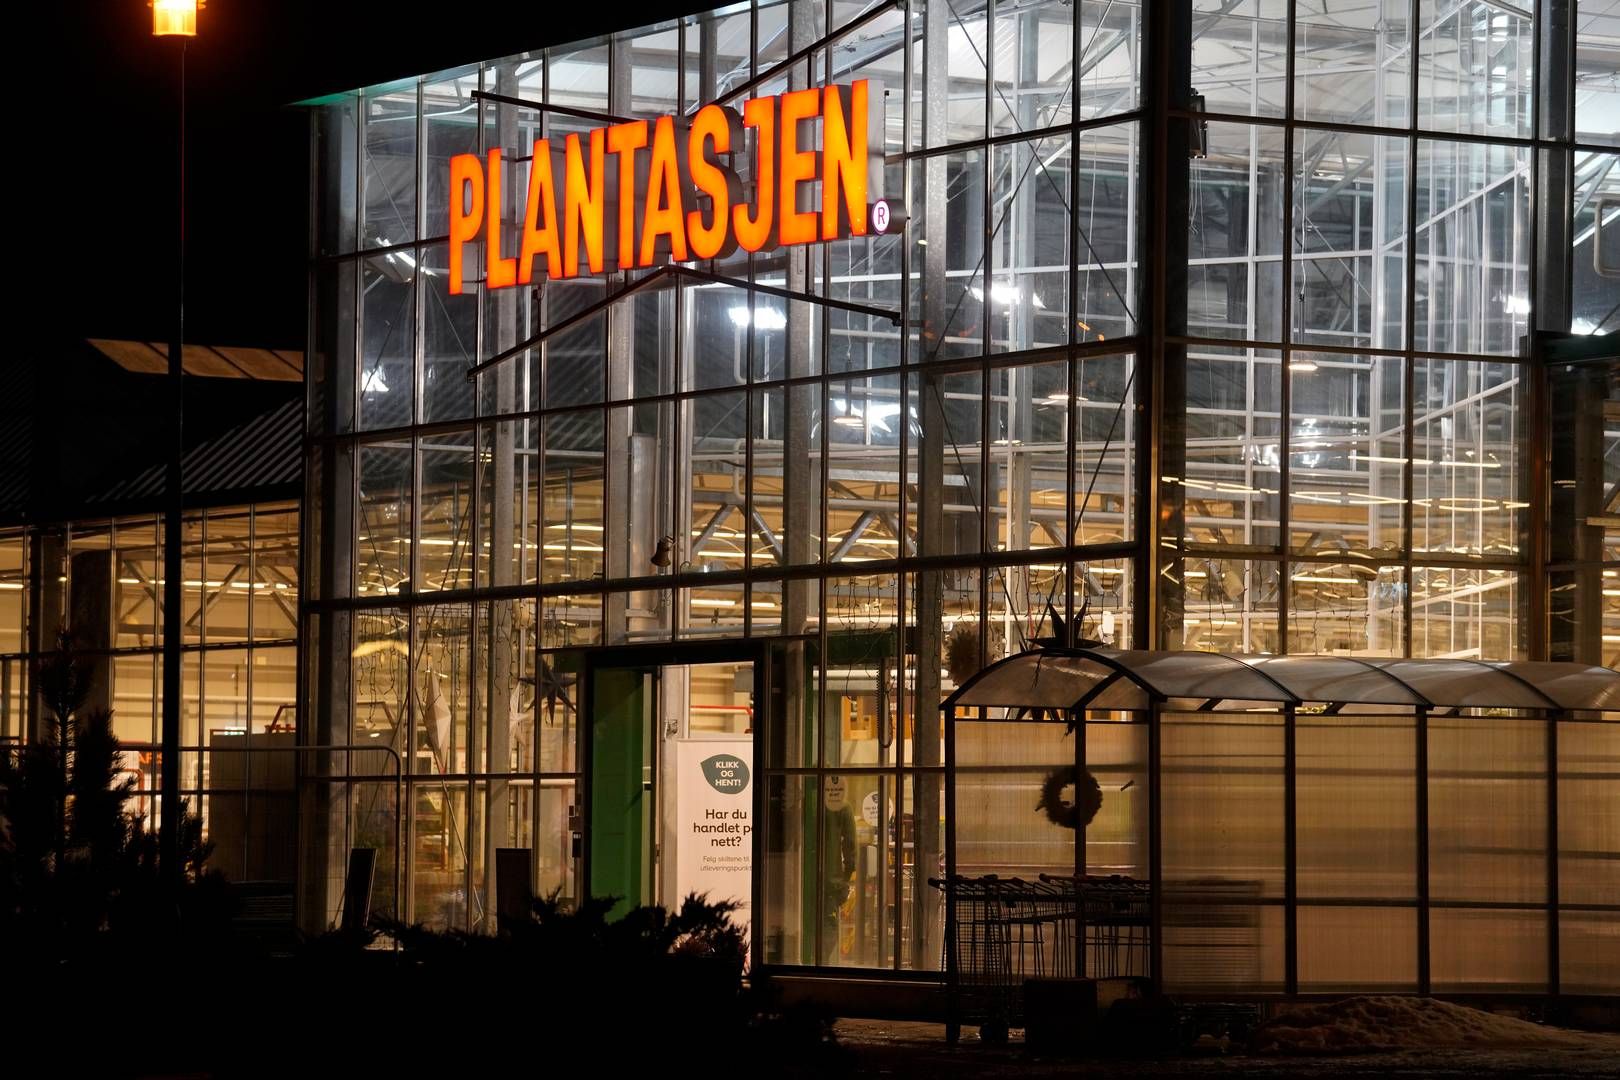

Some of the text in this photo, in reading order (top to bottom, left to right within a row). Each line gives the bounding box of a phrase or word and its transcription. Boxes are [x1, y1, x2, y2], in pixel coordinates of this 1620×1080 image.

[449, 79, 868, 295] PLANTASJEN
[715, 761, 739, 769] KLIKK
[715, 779, 742, 787] HENT!
[705, 809, 747, 820] Har du
[693, 822, 753, 836] handlet p
[711, 836, 742, 847] nett?
